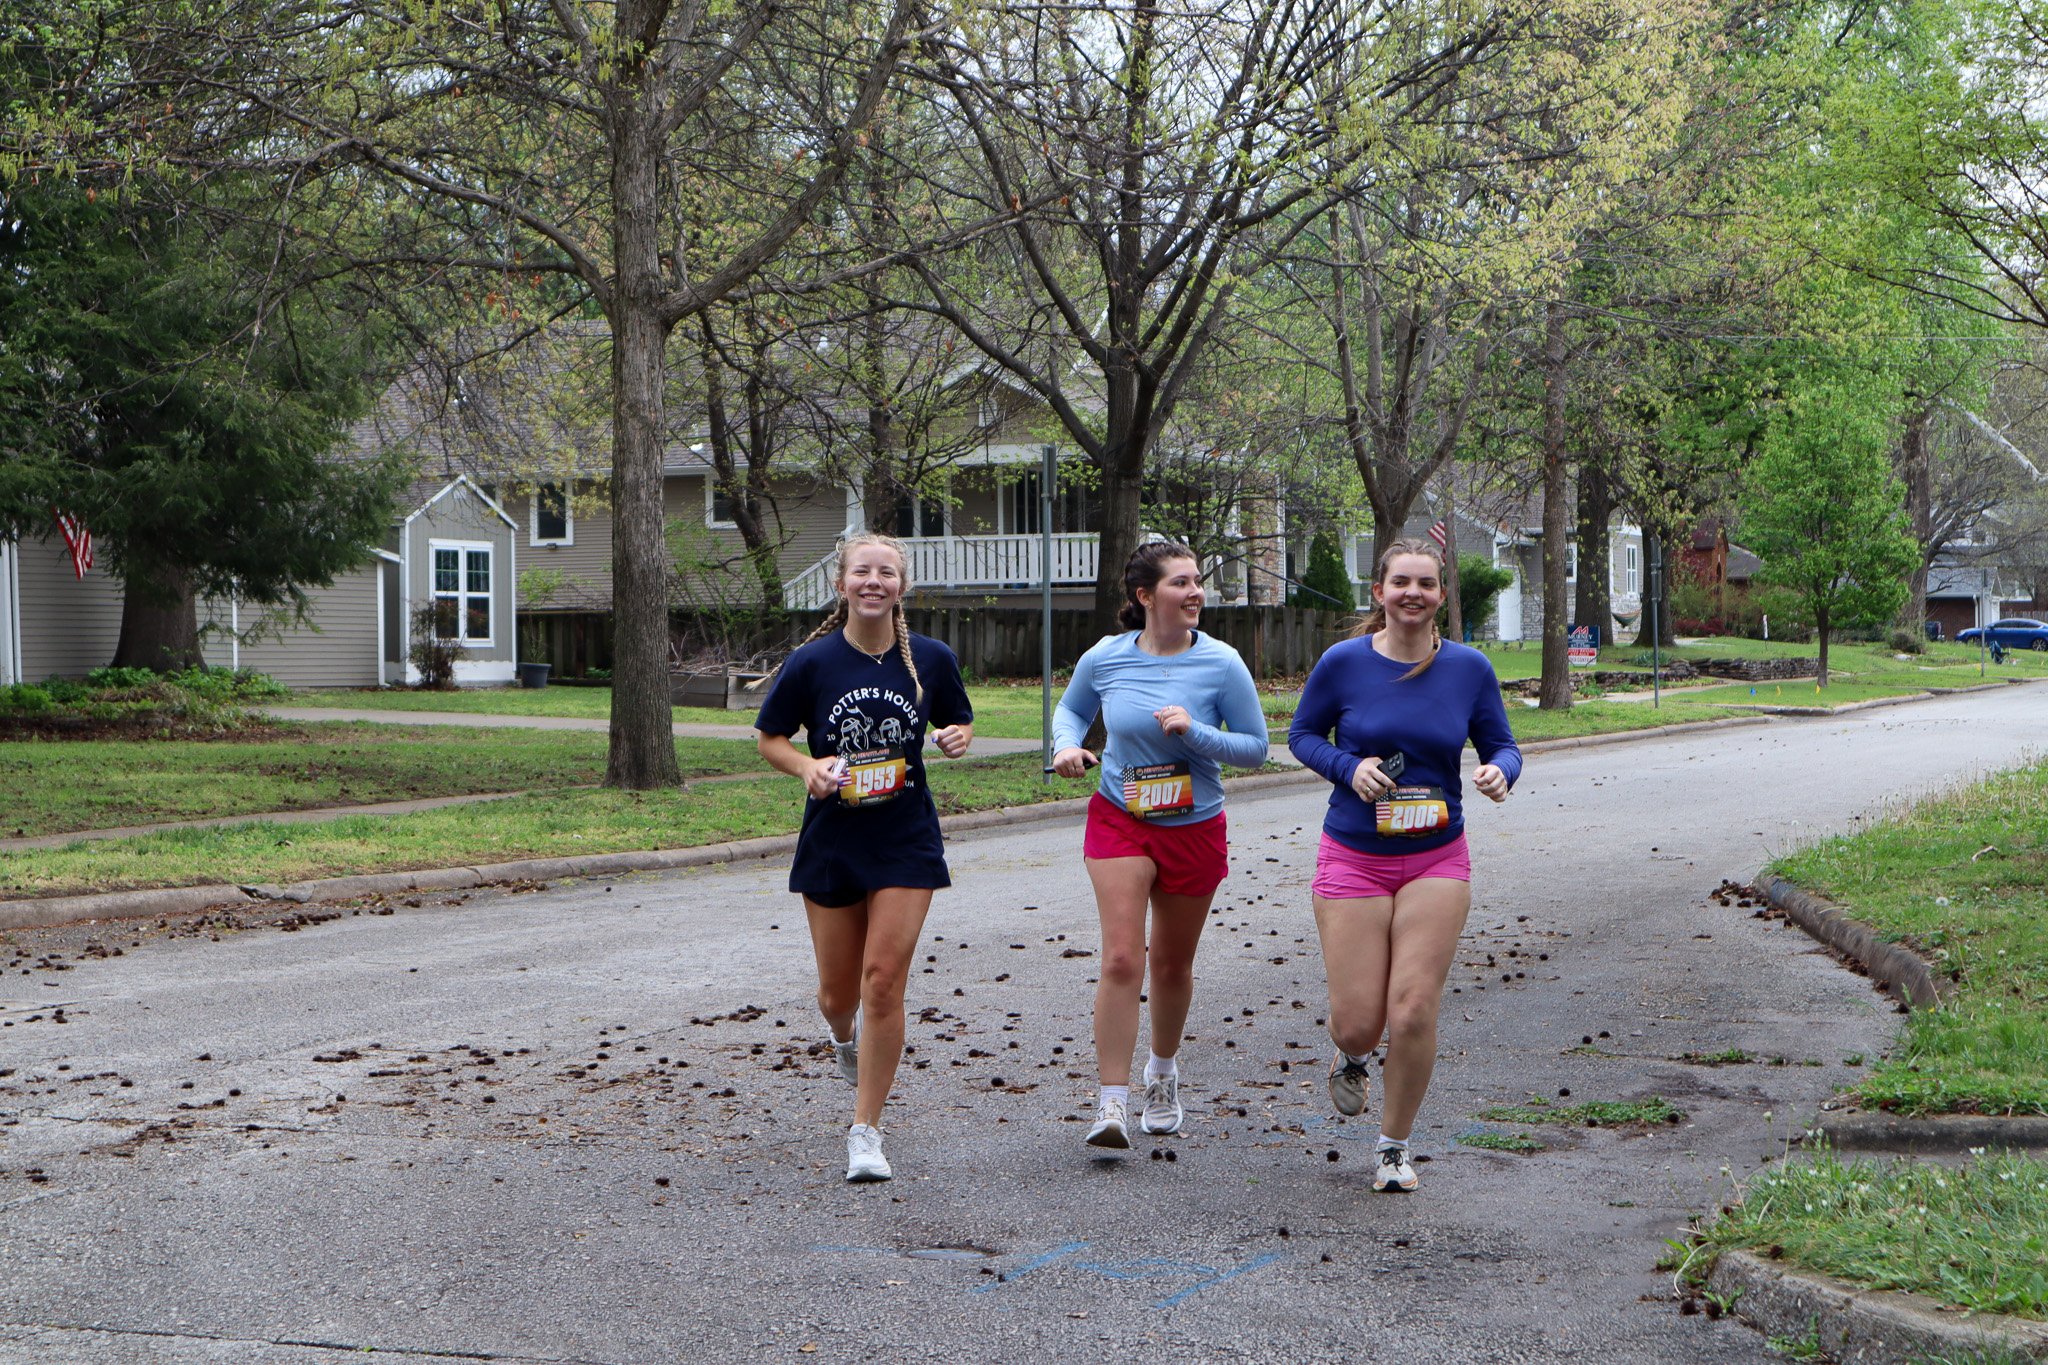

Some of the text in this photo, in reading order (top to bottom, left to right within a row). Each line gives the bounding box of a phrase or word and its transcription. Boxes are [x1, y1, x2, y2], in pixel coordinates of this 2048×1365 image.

[828, 686, 919, 726] POTTER'S HOUSE
[826, 733, 836, 742] 20
[855, 765, 897, 795] 1953
[1138, 780, 1183, 809] 2007
[1390, 804, 1439, 830] 2006
